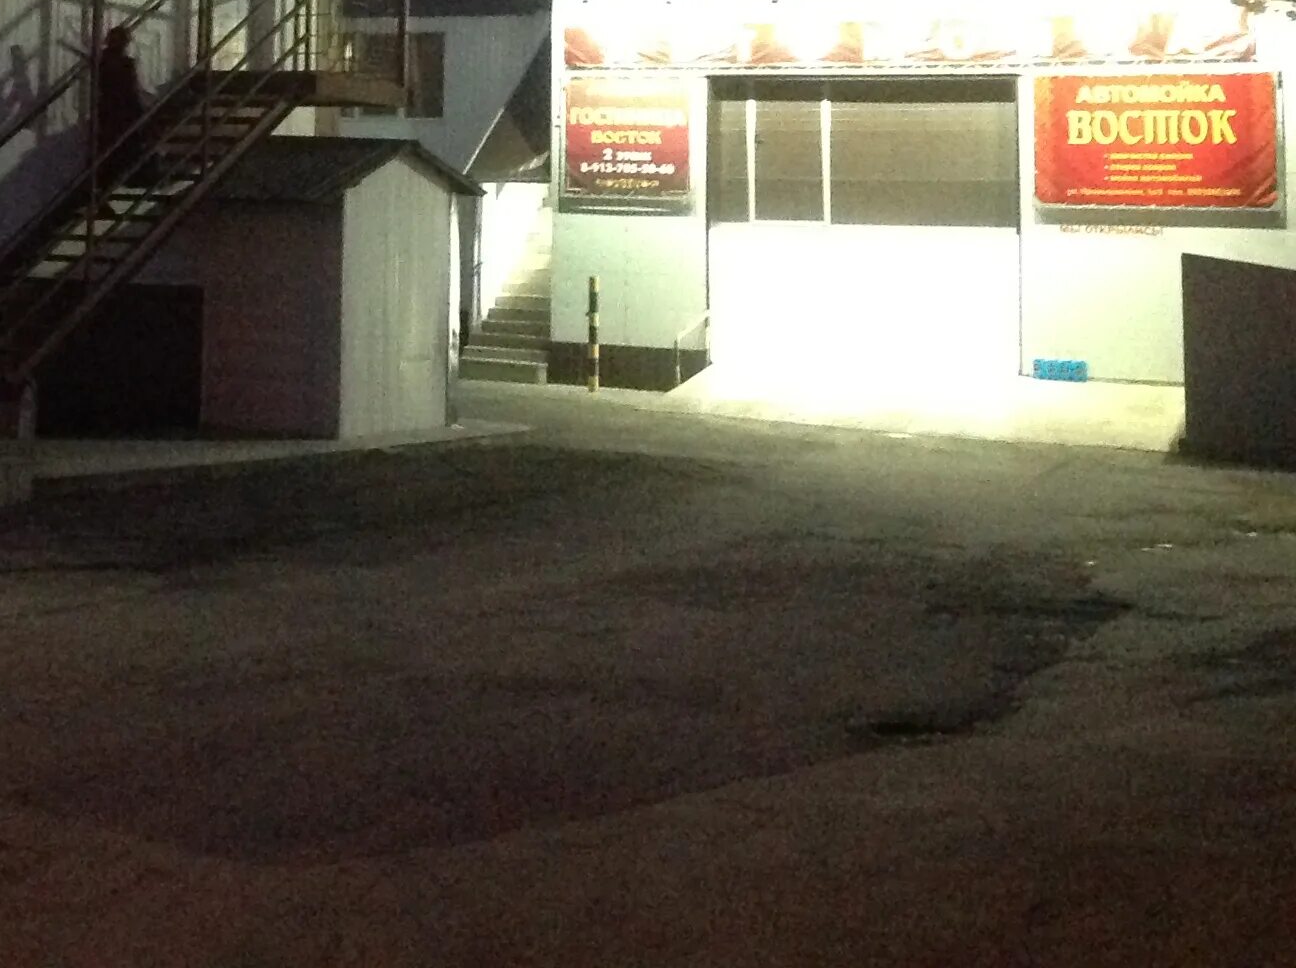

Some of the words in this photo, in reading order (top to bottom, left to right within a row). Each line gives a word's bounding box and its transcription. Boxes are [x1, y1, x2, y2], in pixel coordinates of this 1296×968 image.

[1075, 80, 1227, 103] АВТОМОЙКА
[1066, 109, 1237, 145] ВОСТОК
[591, 129, 663, 145] ВОСТОК
[603, 147, 613, 161] 2
